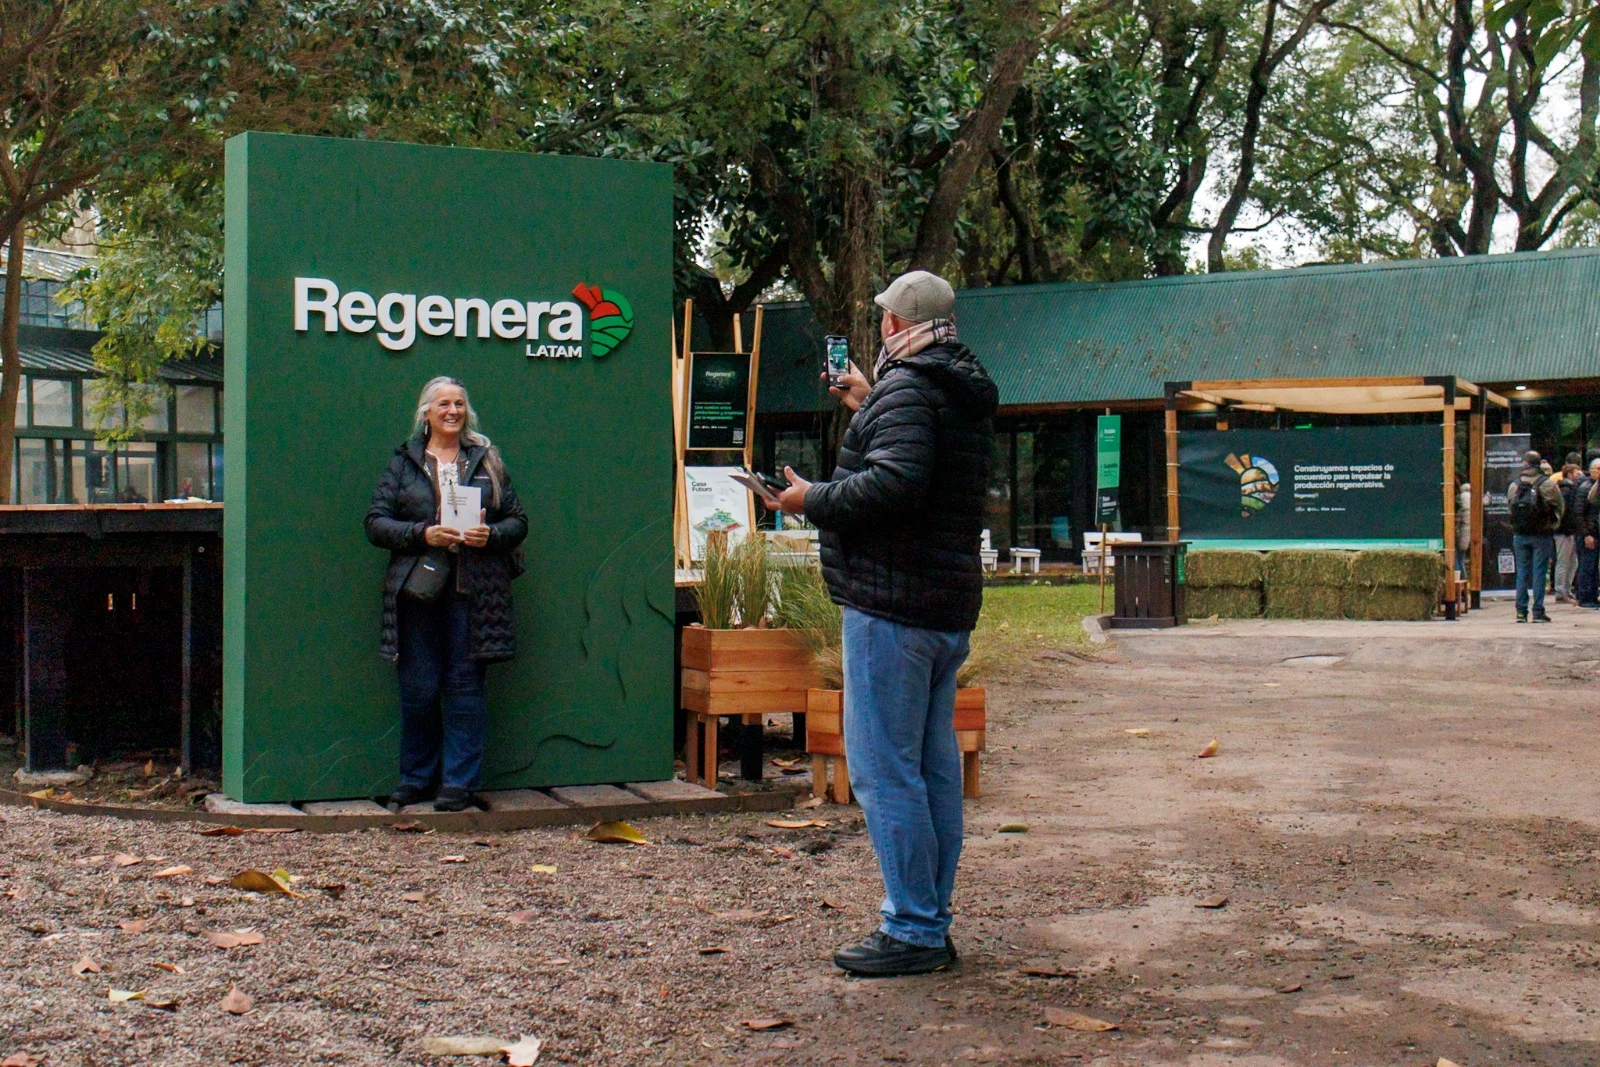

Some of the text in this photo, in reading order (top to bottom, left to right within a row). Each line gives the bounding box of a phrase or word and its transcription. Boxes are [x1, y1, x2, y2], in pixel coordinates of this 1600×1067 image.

[294, 277, 583, 351] Regenera
[525, 344, 582, 358] LATAM
[1294, 465, 1348, 473] Construyamos
[1350, 464, 1382, 472] espacios
[1351, 473, 1382, 481] impulsar
[1383, 472, 1391, 480] la
[1294, 481, 1385, 490] producción regenerativa.
